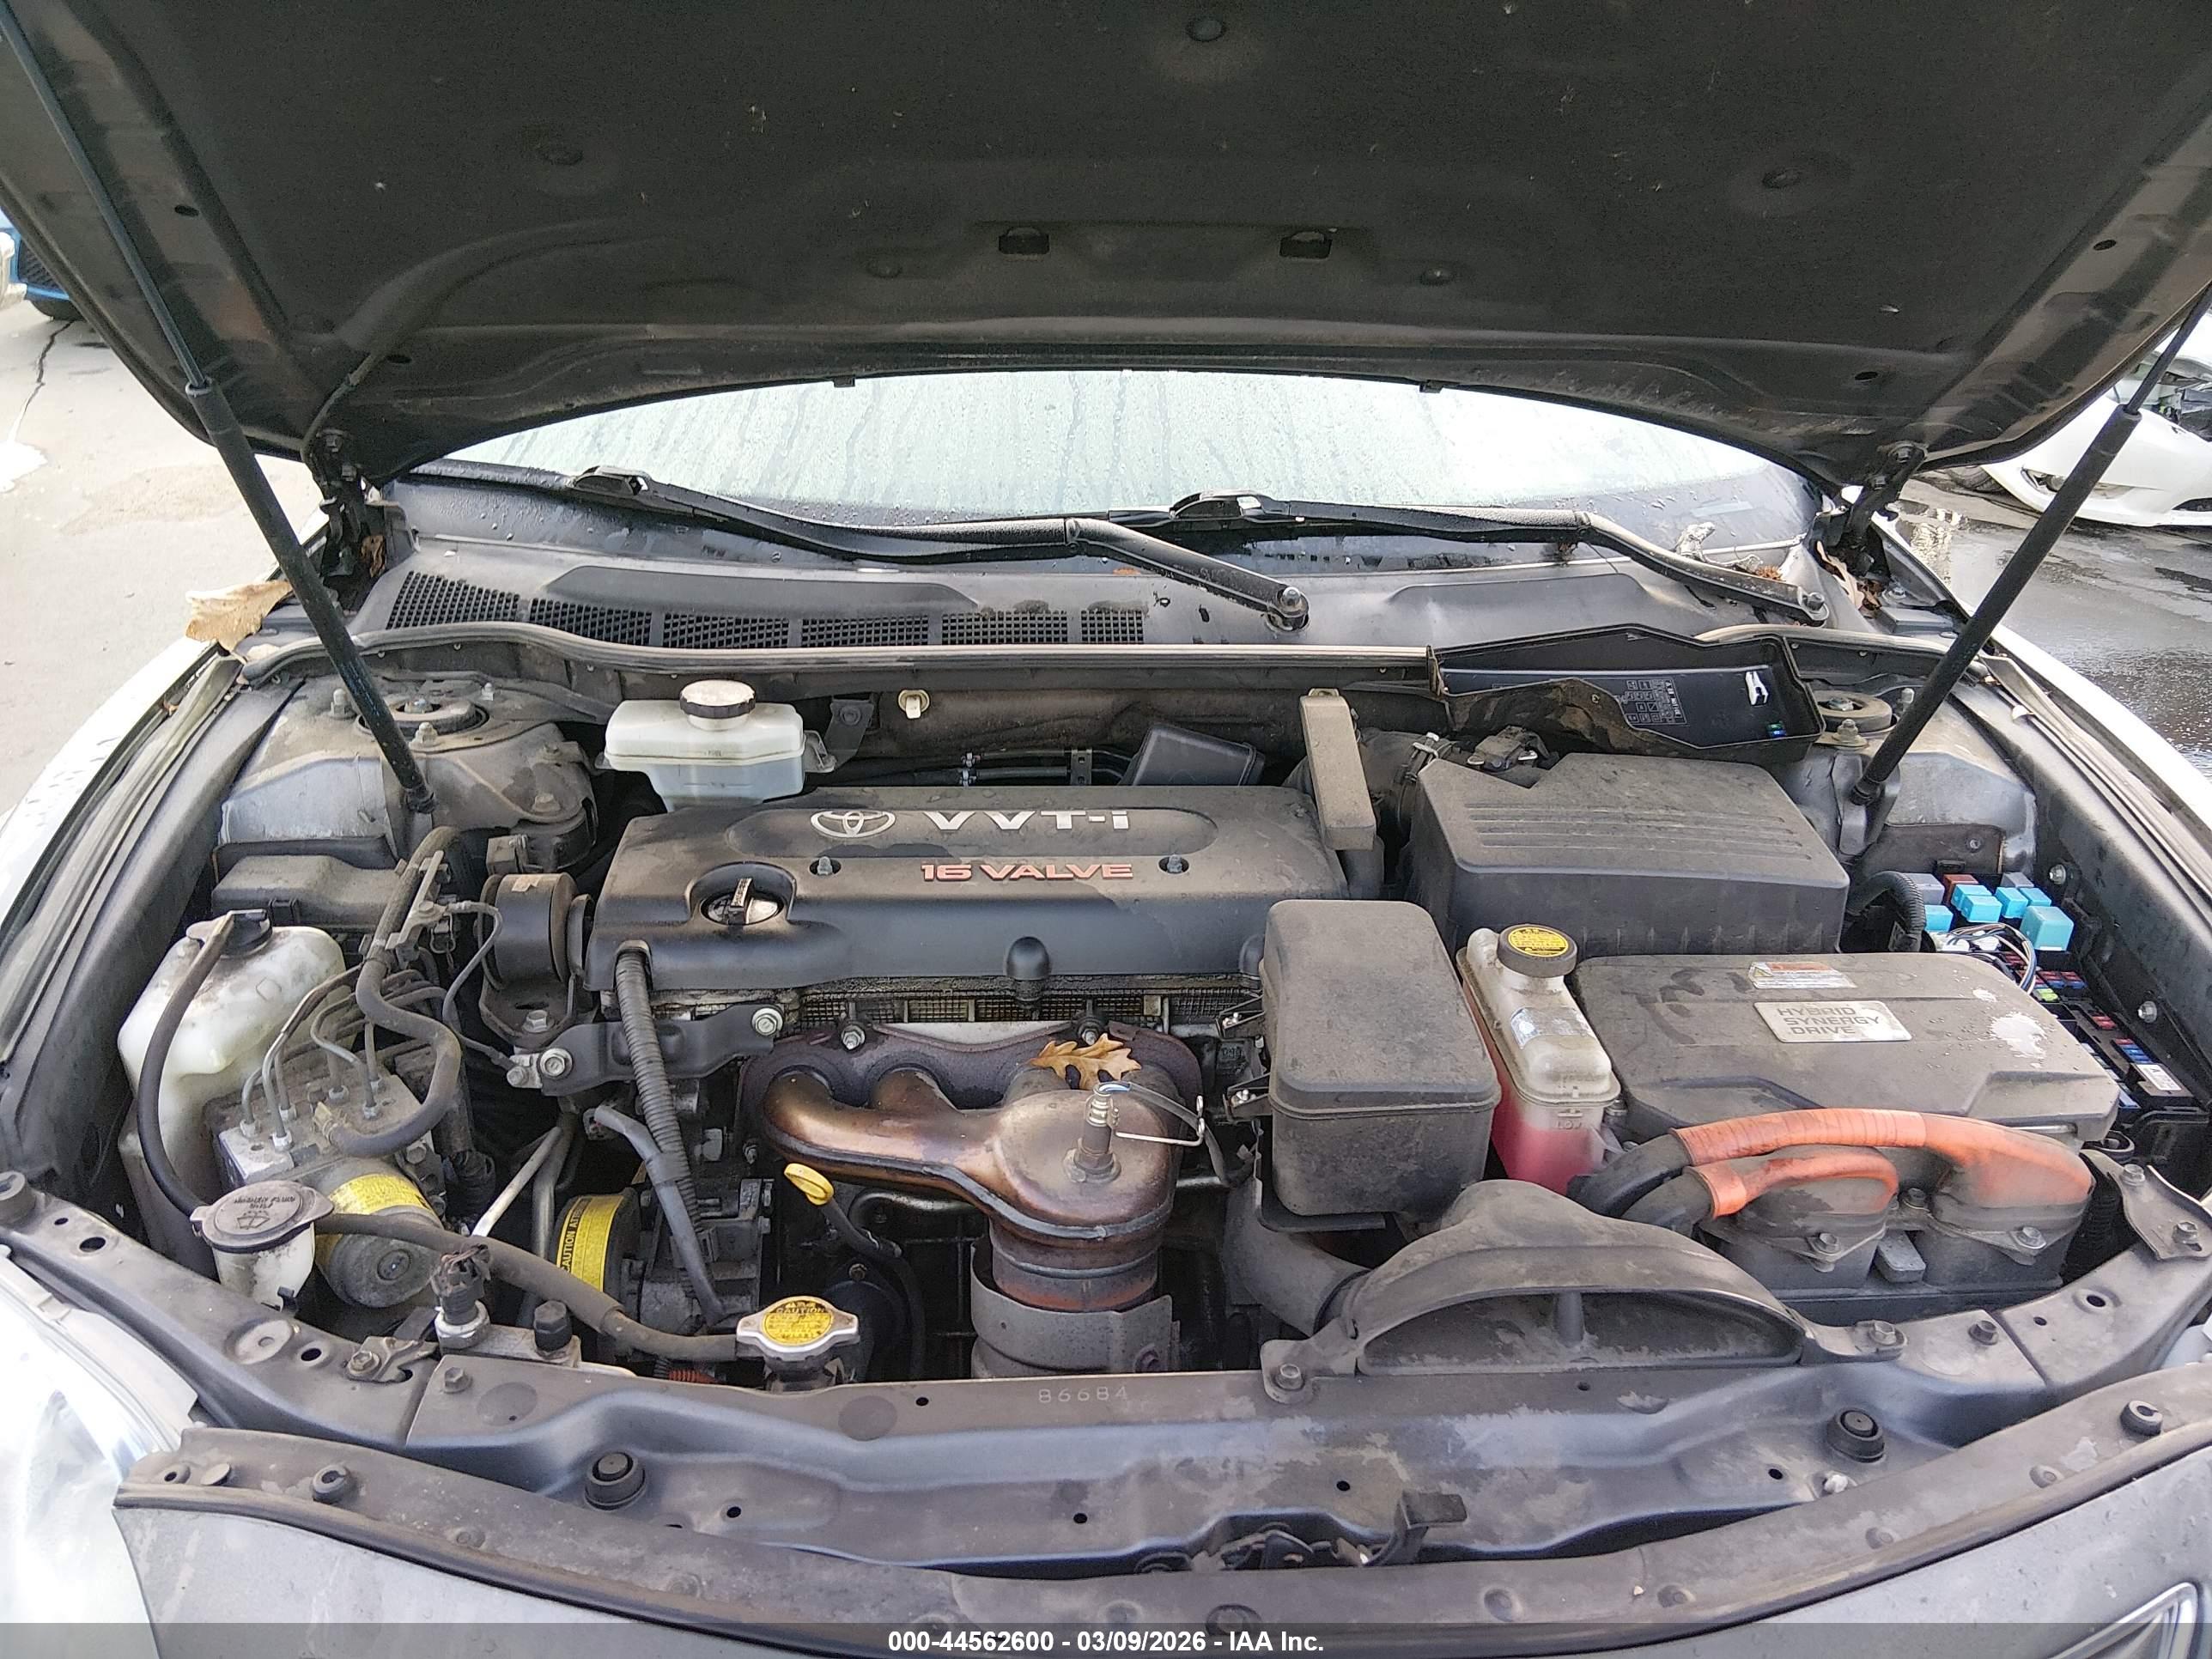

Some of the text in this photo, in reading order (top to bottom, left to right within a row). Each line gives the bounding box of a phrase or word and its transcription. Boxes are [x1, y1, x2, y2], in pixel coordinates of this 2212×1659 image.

[923, 810, 1130, 830] VVT-i
[921, 863, 1133, 882] 16 VALVE
[1778, 1007, 1856, 1017] HYBRID
[1784, 1017, 1880, 1026] SYNERGY
[1791, 1026, 1856, 1035] DRIVE
[561, 1231, 576, 1273] CAUTION
[1038, 1386, 1127, 1403] 86684
